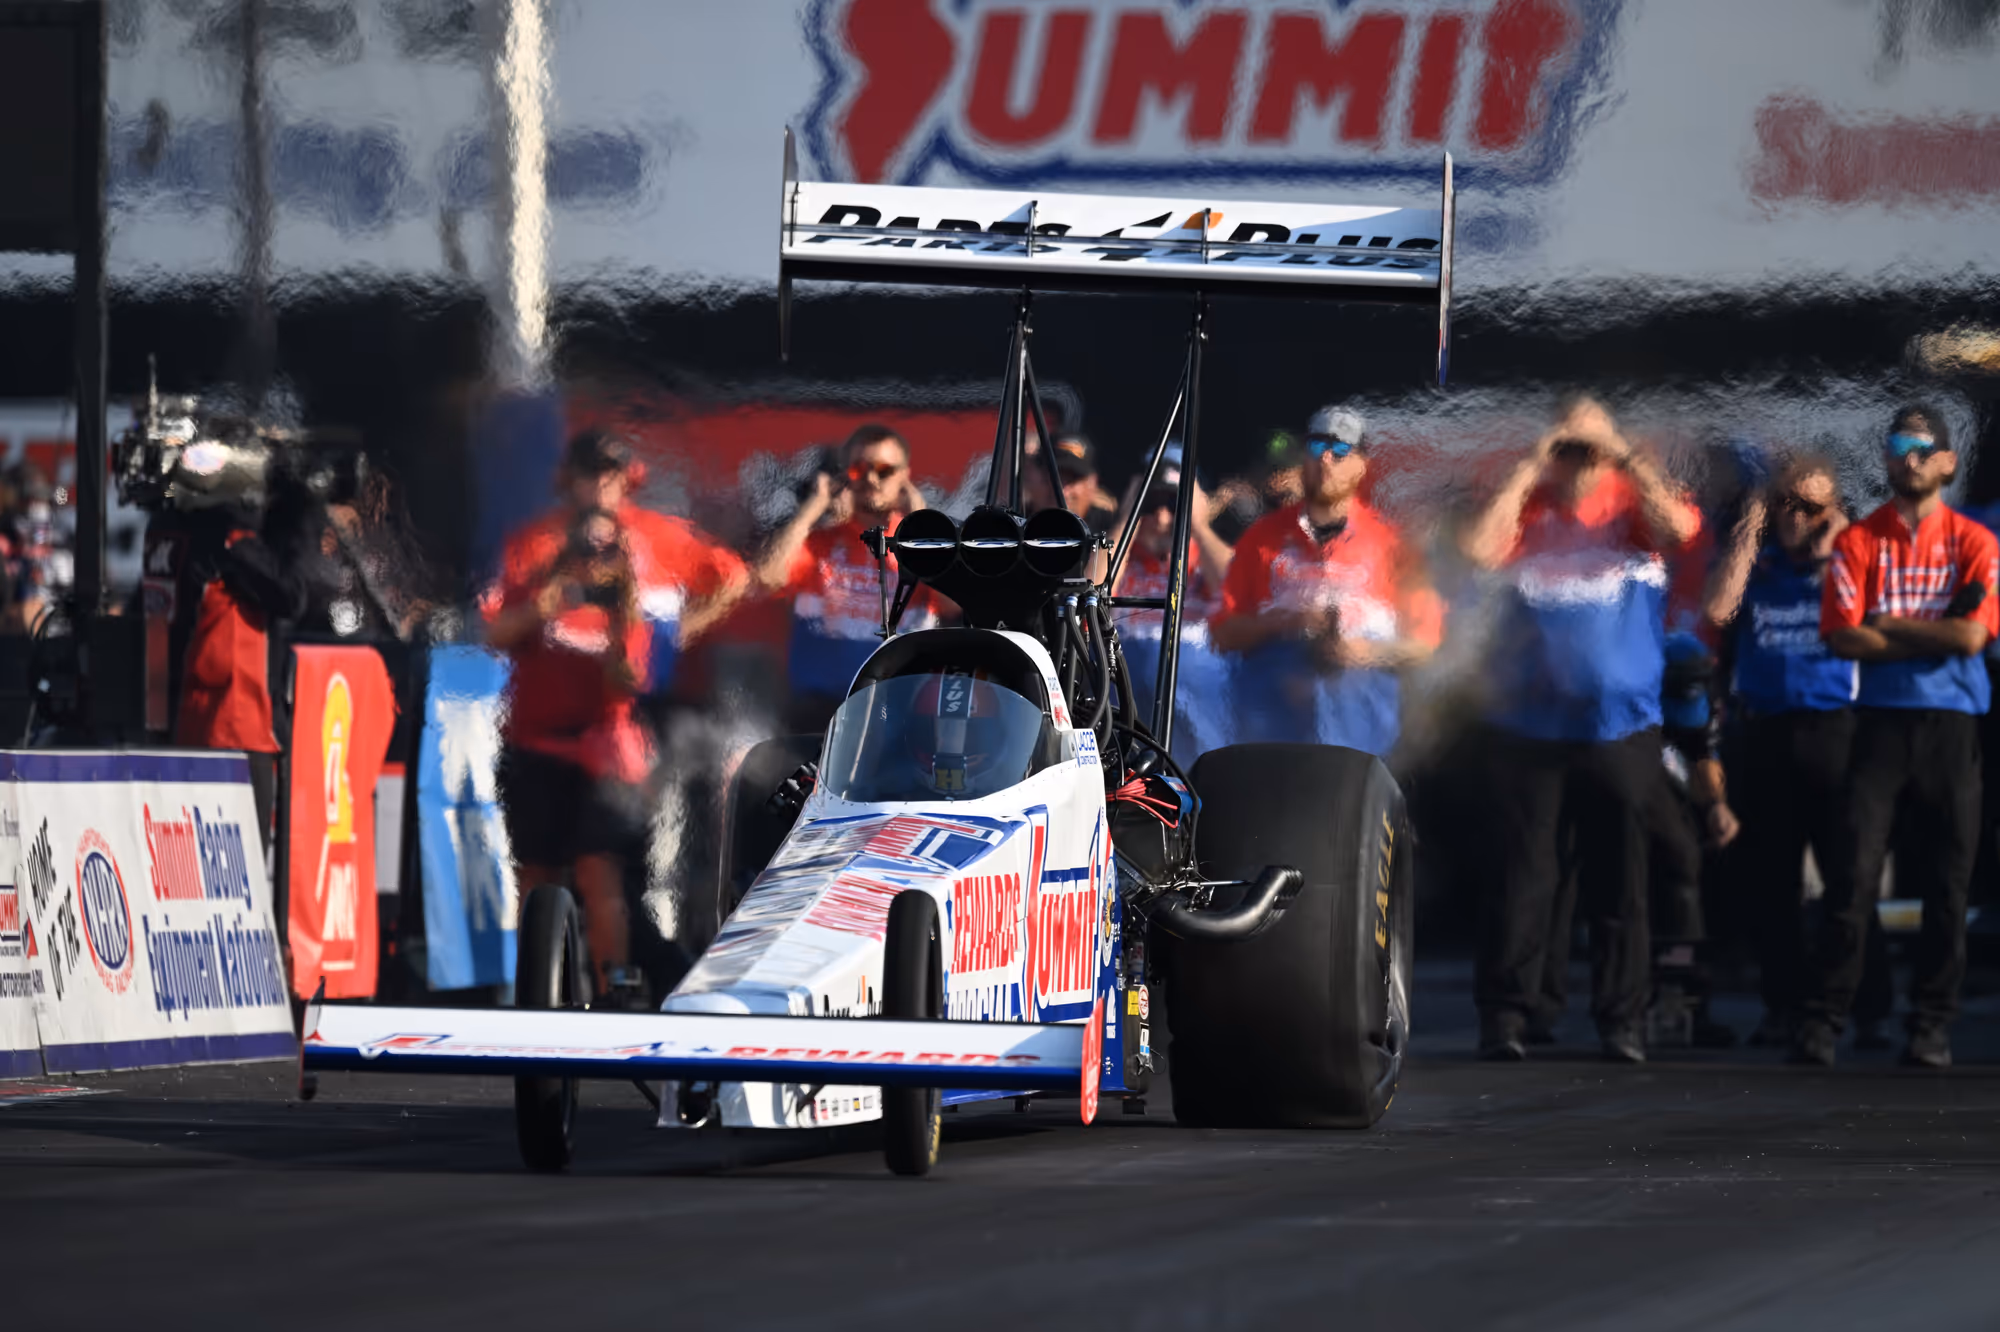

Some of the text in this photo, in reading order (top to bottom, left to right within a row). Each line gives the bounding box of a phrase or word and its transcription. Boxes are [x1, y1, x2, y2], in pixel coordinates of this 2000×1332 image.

[840, 0, 1585, 184] SUMMIT
[1211, 222, 1439, 269] PLUS
[27, 816, 56, 923] HOME
[143, 802, 204, 901] Summit
[193, 804, 252, 911] Racing
[58, 884, 80, 975] THE
[83, 855, 128, 967] NHRA
[951, 872, 1021, 975] REWARDS
[1025, 825, 1096, 1022] SUMMIT
[142, 914, 223, 1022] Equipment
[717, 1047, 1040, 1066] REWARDS
